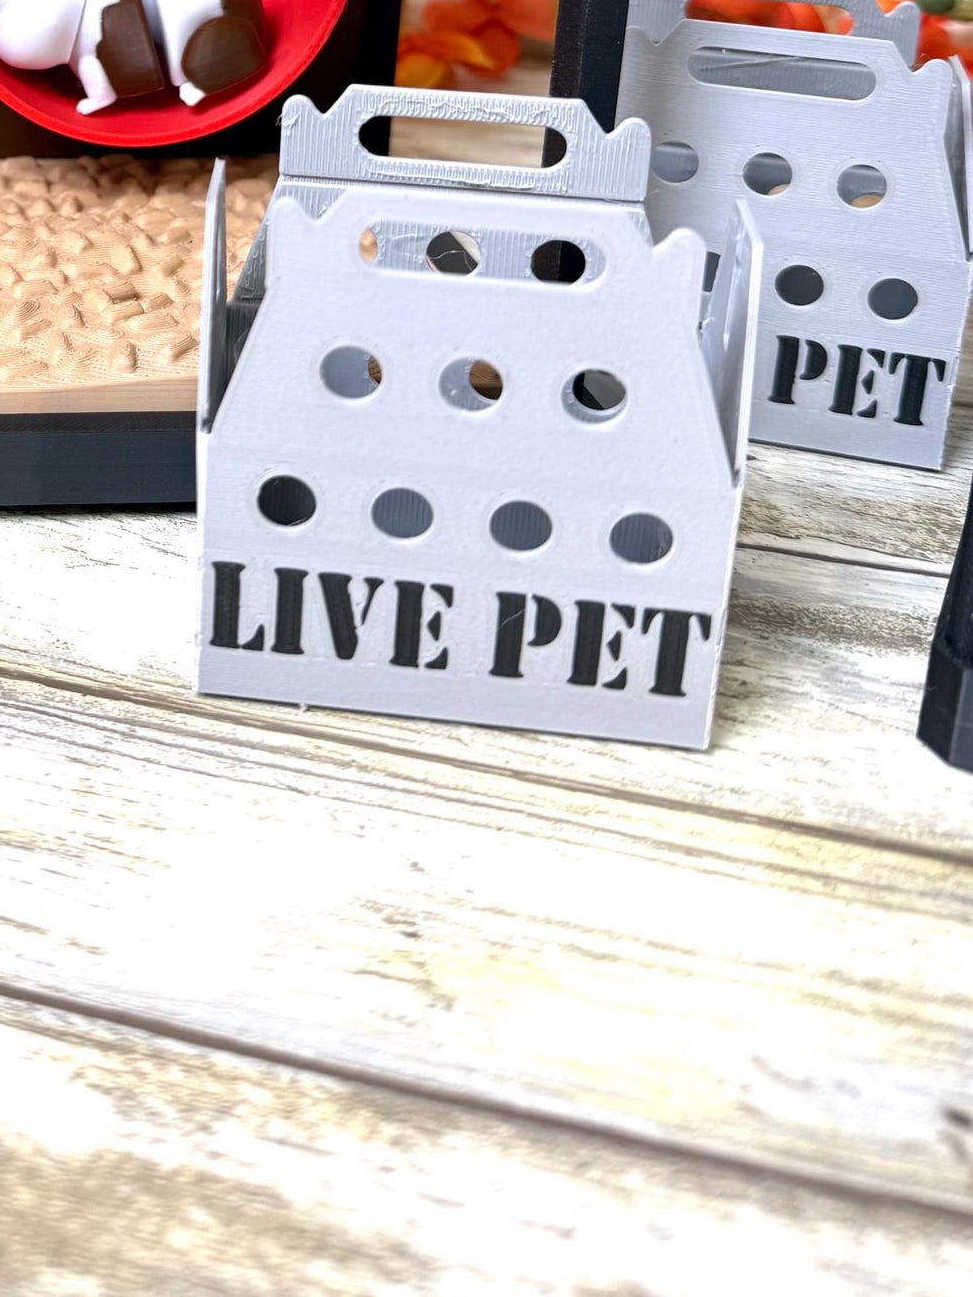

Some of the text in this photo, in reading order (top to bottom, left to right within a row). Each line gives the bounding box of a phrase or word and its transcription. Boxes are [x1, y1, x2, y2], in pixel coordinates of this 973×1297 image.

[767, 334, 946, 426] PET
[209, 561, 712, 696] LIVE PET
